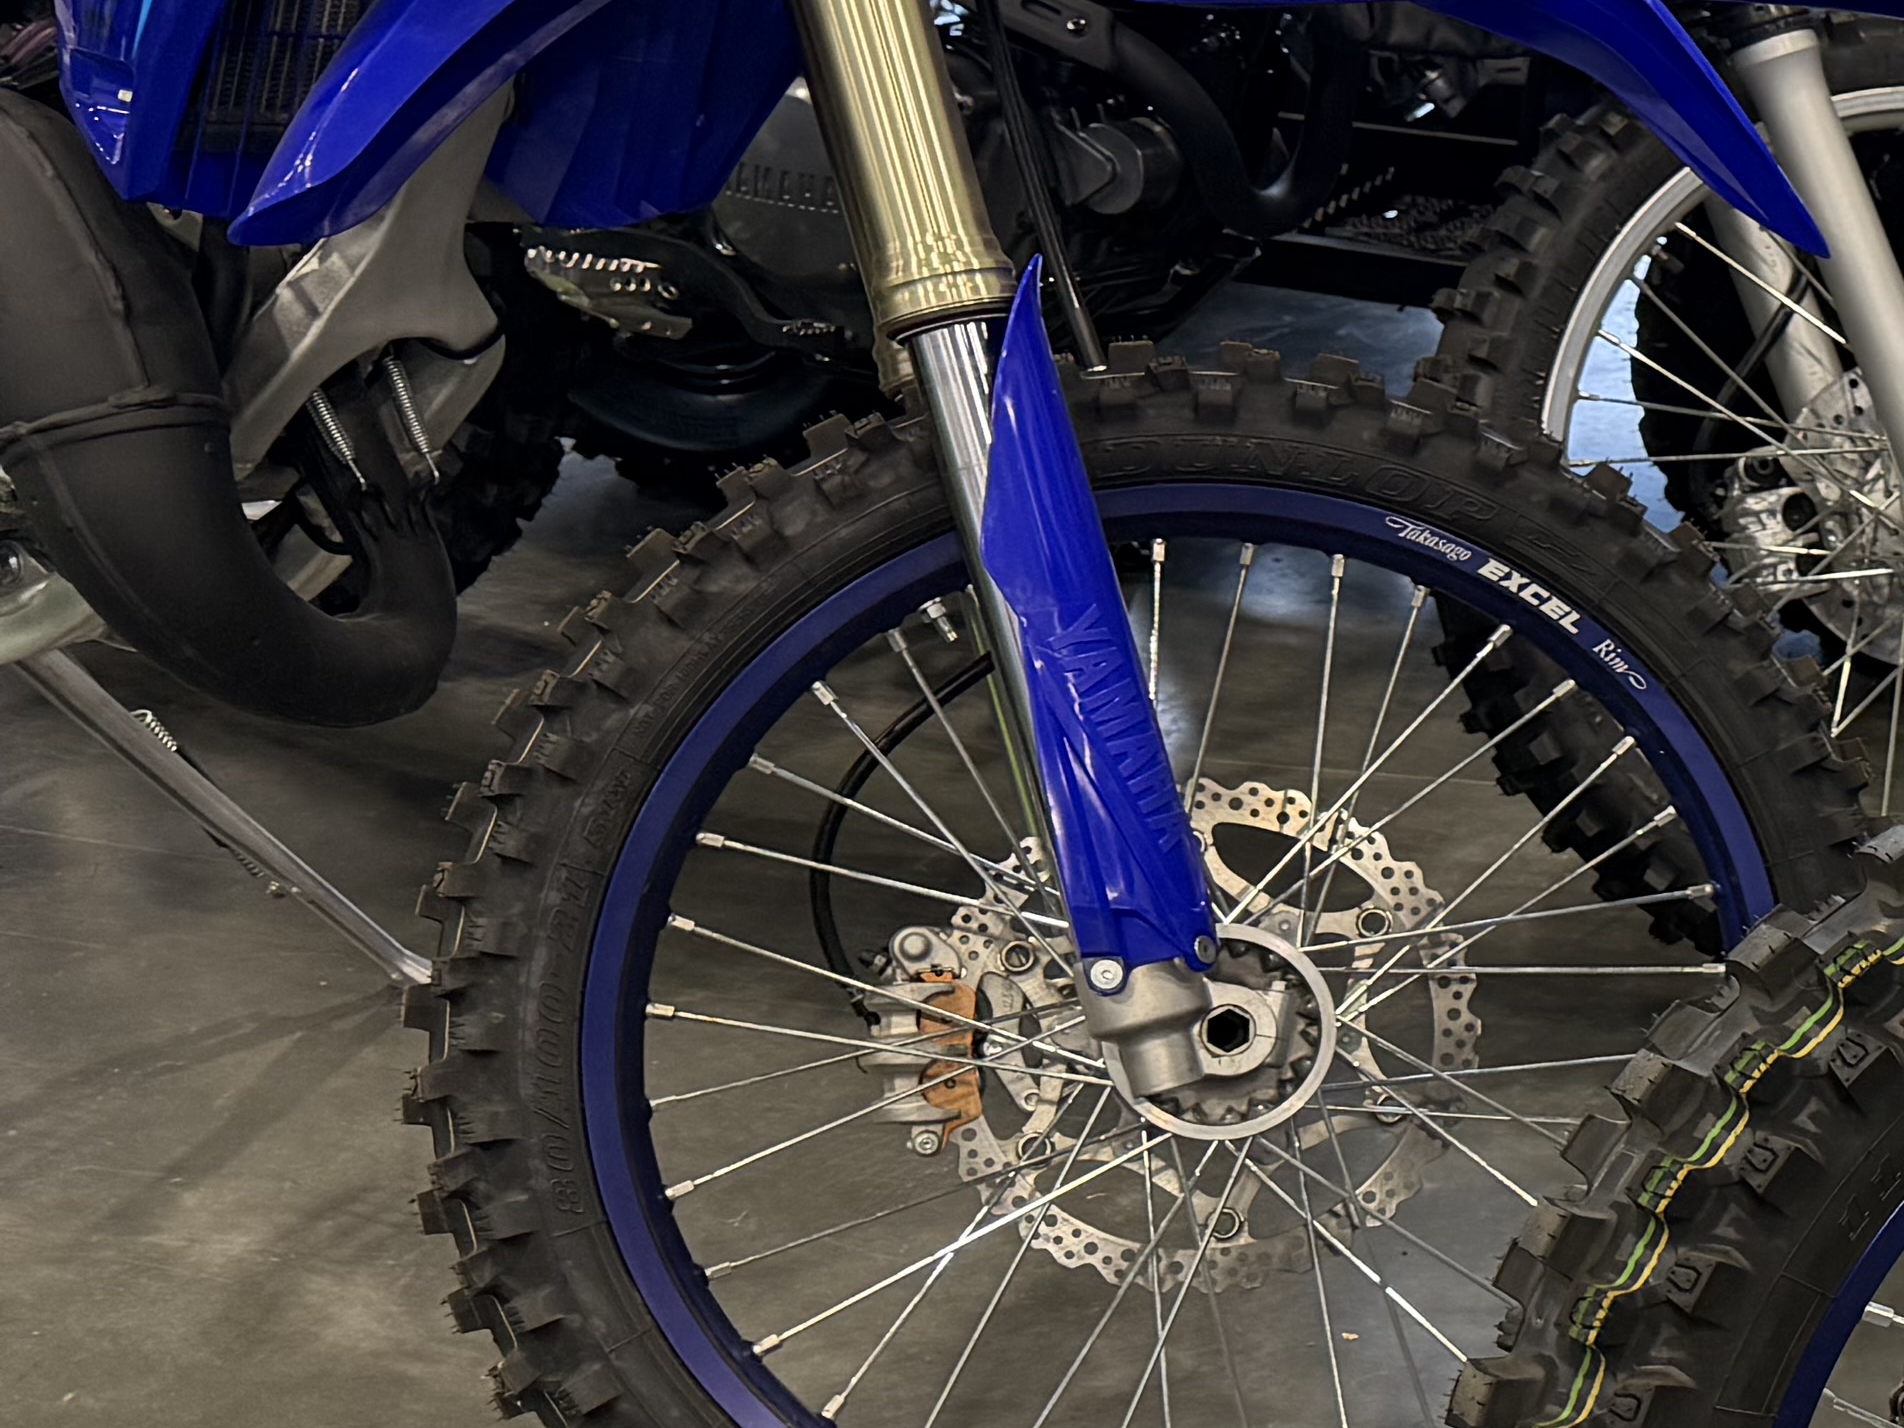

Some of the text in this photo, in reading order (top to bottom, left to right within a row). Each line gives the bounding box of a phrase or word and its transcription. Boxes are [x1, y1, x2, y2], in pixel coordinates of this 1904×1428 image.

[1385, 515, 1647, 691] Takasago EXCEL Rim
[1048, 603, 1192, 855] YAMAHA
